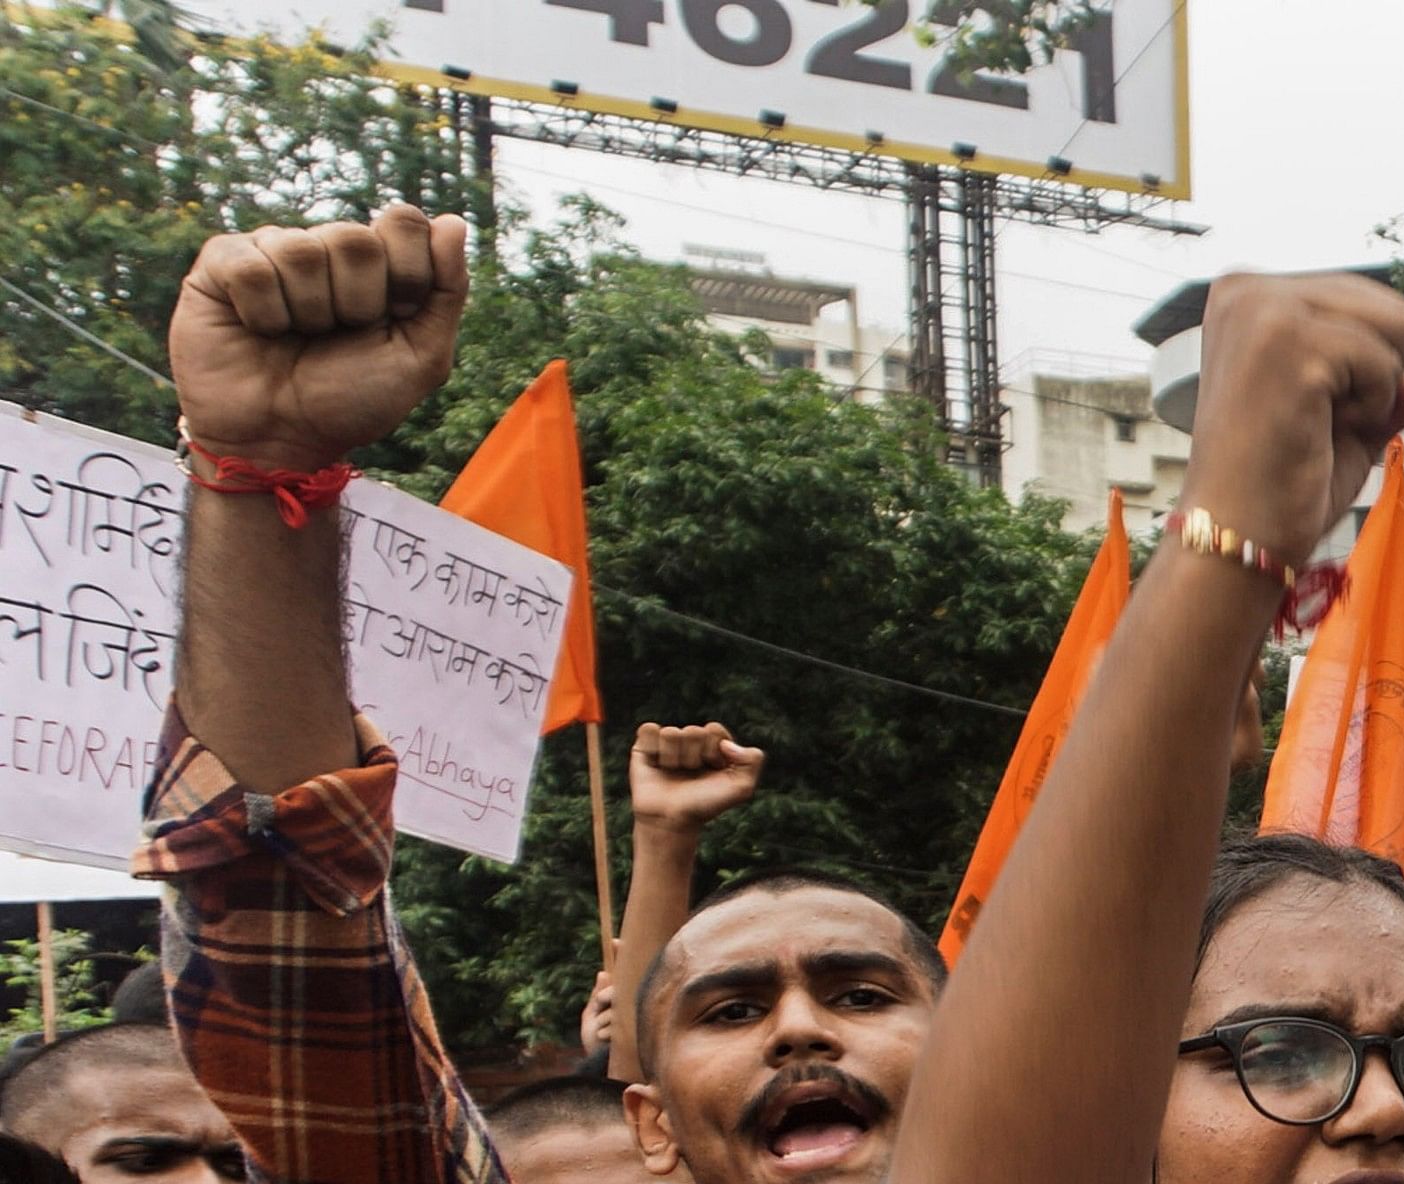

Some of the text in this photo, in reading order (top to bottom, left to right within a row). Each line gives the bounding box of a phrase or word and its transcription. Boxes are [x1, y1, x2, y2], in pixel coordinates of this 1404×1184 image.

[371, 517, 429, 592] एक
[435, 551, 508, 618] काम
[503, 575, 564, 641] करो
[59, 583, 177, 713] जिंद
[380, 613, 492, 686] आराम
[485, 651, 549, 719] करो
